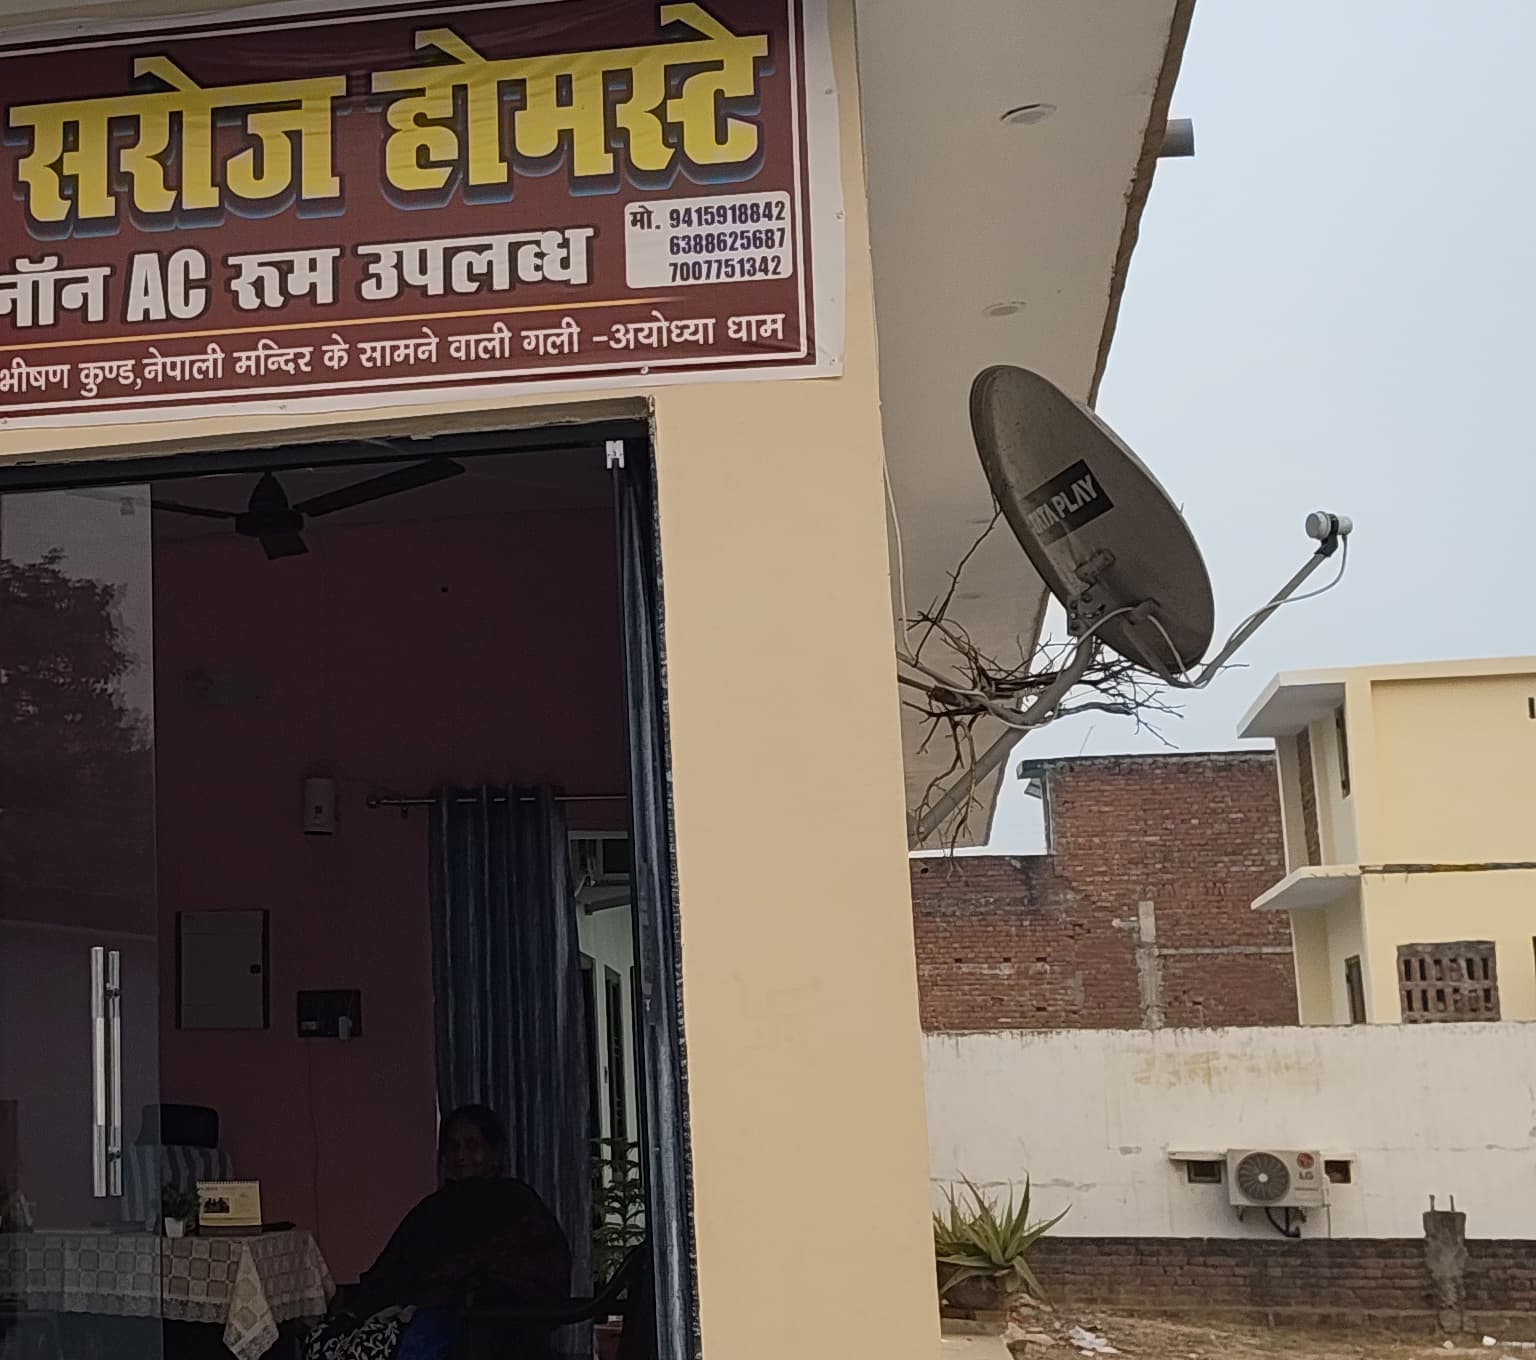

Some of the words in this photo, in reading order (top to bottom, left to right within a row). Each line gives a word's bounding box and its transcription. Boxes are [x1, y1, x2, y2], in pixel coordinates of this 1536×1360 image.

[10, 56, 346, 221] सरोज
[371, 2, 768, 191] होमस्टे
[629, 205, 661, 231] मो.
[669, 201, 785, 228] 9415918842
[669, 228, 785, 255] 6388625687
[126, 249, 207, 322] AC
[358, 228, 594, 301] उपलब्ध
[669, 255, 781, 282] 7007751342
[233, 338, 313, 377] मन्दिर
[324, 333, 349, 372] के
[358, 326, 439, 369] सामने
[449, 322, 510, 362] वाली
[521, 317, 581, 355] गली
[727, 311, 785, 344] धाम
[1051, 473, 1098, 519] PLAY
